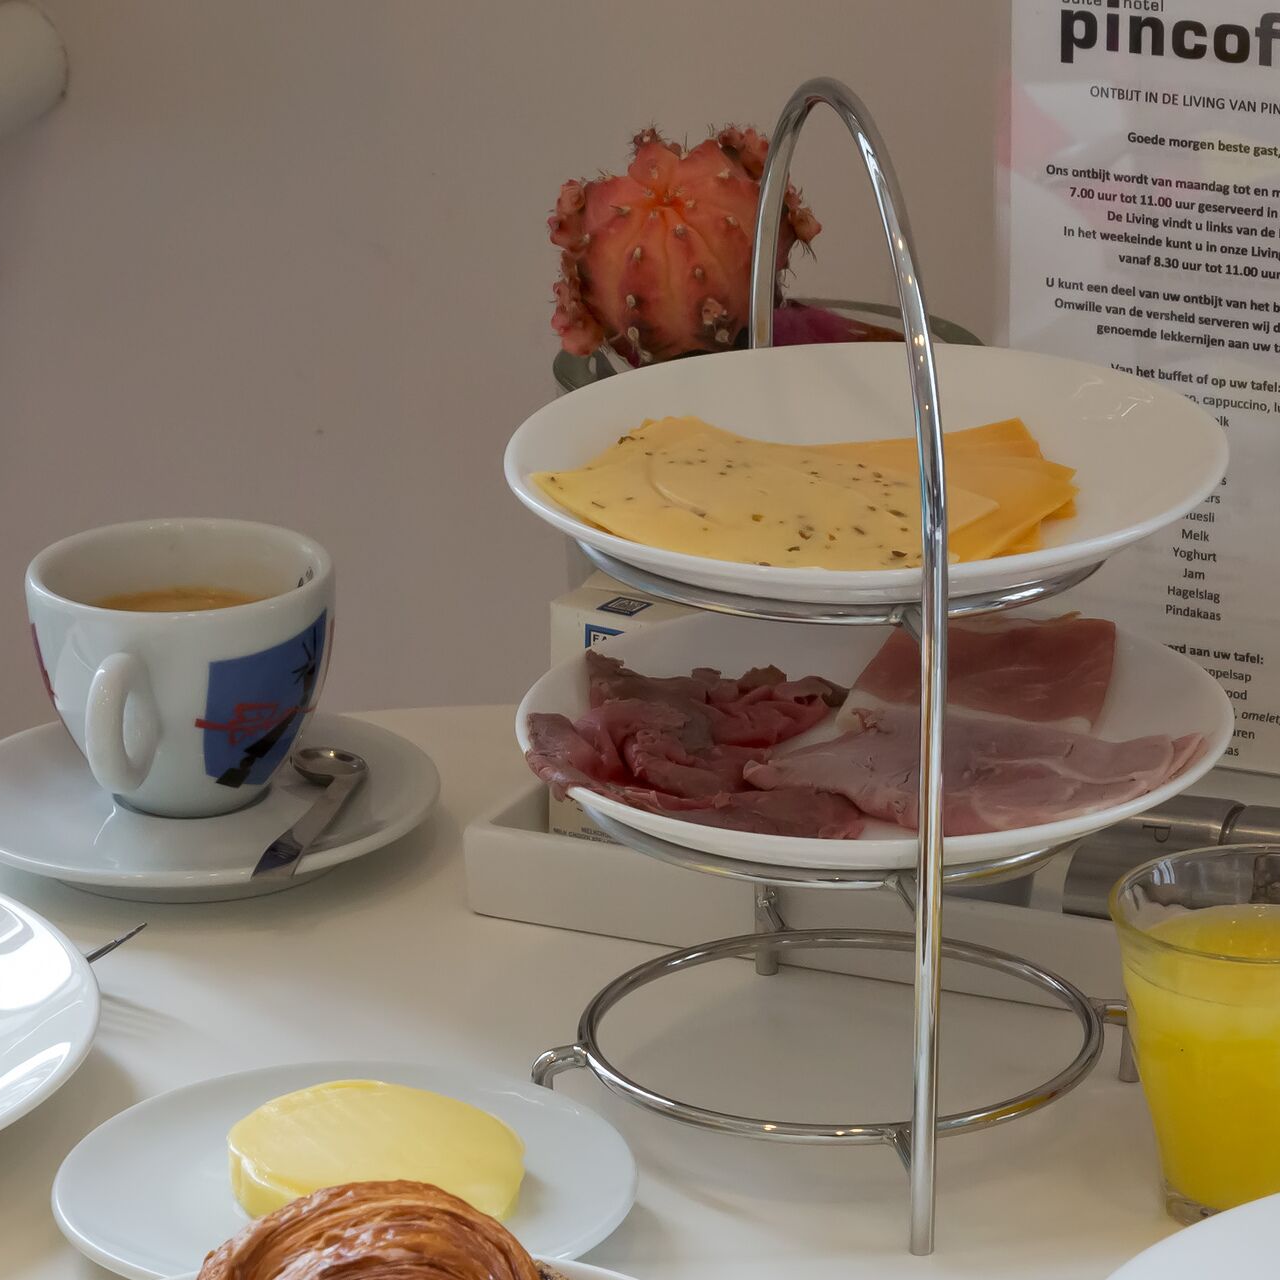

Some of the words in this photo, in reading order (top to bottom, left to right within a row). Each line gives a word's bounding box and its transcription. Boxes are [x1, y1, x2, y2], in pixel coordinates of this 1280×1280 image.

[1089, 85, 1143, 103] ONTBIJT
[1144, 91, 1159, 104] IN
[1161, 92, 1179, 107] DE
[1182, 94, 1226, 111] LIVING
[1228, 98, 1257, 113] VAN
[1127, 131, 1166, 147] Goede
[1168, 137, 1215, 152] morgen
[1217, 139, 1251, 155] beste
[1045, 163, 1069, 177] Ons
[1071, 167, 1111, 183] ontbijt
[1113, 173, 1149, 186] wordt
[1150, 177, 1173, 188] van
[1175, 179, 1231, 195] maandag
[1232, 183, 1251, 196] tot
[1253, 187, 1269, 197] en
[1069, 186, 1095, 200] 7.00
[1097, 191, 1118, 203] uur
[1119, 192, 1138, 205] tot
[1139, 194, 1173, 209] 11.00
[1174, 200, 1197, 211] uur
[1197, 202, 1265, 218] geserveerd
[1266, 206, 1279, 219] in
[1107, 209, 1123, 223] De
[1125, 211, 1160, 229] Living
[1161, 216, 1193, 231] vindt
[1195, 221, 1203, 231] u
[1205, 219, 1234, 235] links
[1235, 225, 1258, 237] van
[1259, 225, 1276, 239] de
[1063, 225, 1075, 237] In
[1077, 225, 1098, 240] het
[1099, 231, 1163, 247] weekeinde
[1165, 235, 1193, 251] kunt
[1195, 242, 1203, 252] u
[1205, 240, 1218, 253] in
[1219, 245, 1249, 257] onze
[1117, 254, 1152, 267] vanaf
[1153, 255, 1180, 270] 8.30
[1181, 261, 1203, 272] uur
[1204, 262, 1223, 275] tot
[1224, 263, 1259, 278] 11.00
[1045, 276, 1055, 288] U
[1057, 277, 1085, 292] kunt
[1086, 283, 1109, 295] een
[1110, 283, 1137, 297] deel
[1138, 289, 1160, 300] van
[1162, 291, 1181, 303] uw
[1182, 293, 1224, 309] ontbijt
[1225, 299, 1248, 310] van
[1249, 298, 1271, 313] het
[1053, 297, 1103, 313] Omwille
[1104, 305, 1127, 316] van
[1128, 305, 1144, 319] de
[1145, 309, 1196, 325] versheid
[1197, 315, 1250, 330] serveren
[1251, 320, 1271, 335] wij
[1096, 324, 1158, 340] genoemde
[1159, 328, 1226, 349] lekkernijen
[1227, 339, 1250, 351] aan
[1252, 341, 1272, 353] uw
[1135, 365, 1156, 379] het
[1157, 368, 1194, 384] buffet
[1195, 373, 1209, 385] of
[1210, 377, 1227, 389] op
[1229, 379, 1249, 389] uw
[1202, 396, 1271, 415] cappuccino,
[1181, 528, 1210, 543] Melk
[1172, 546, 1217, 563] Yoghurt
[1182, 567, 1206, 581] Jam
[1167, 585, 1221, 605] Hagelslag
[1165, 603, 1222, 622] Pindakaas
[1189, 647, 1211, 658] aan
[1213, 650, 1231, 661] uw
[1233, 651, 1264, 665] tafel:
